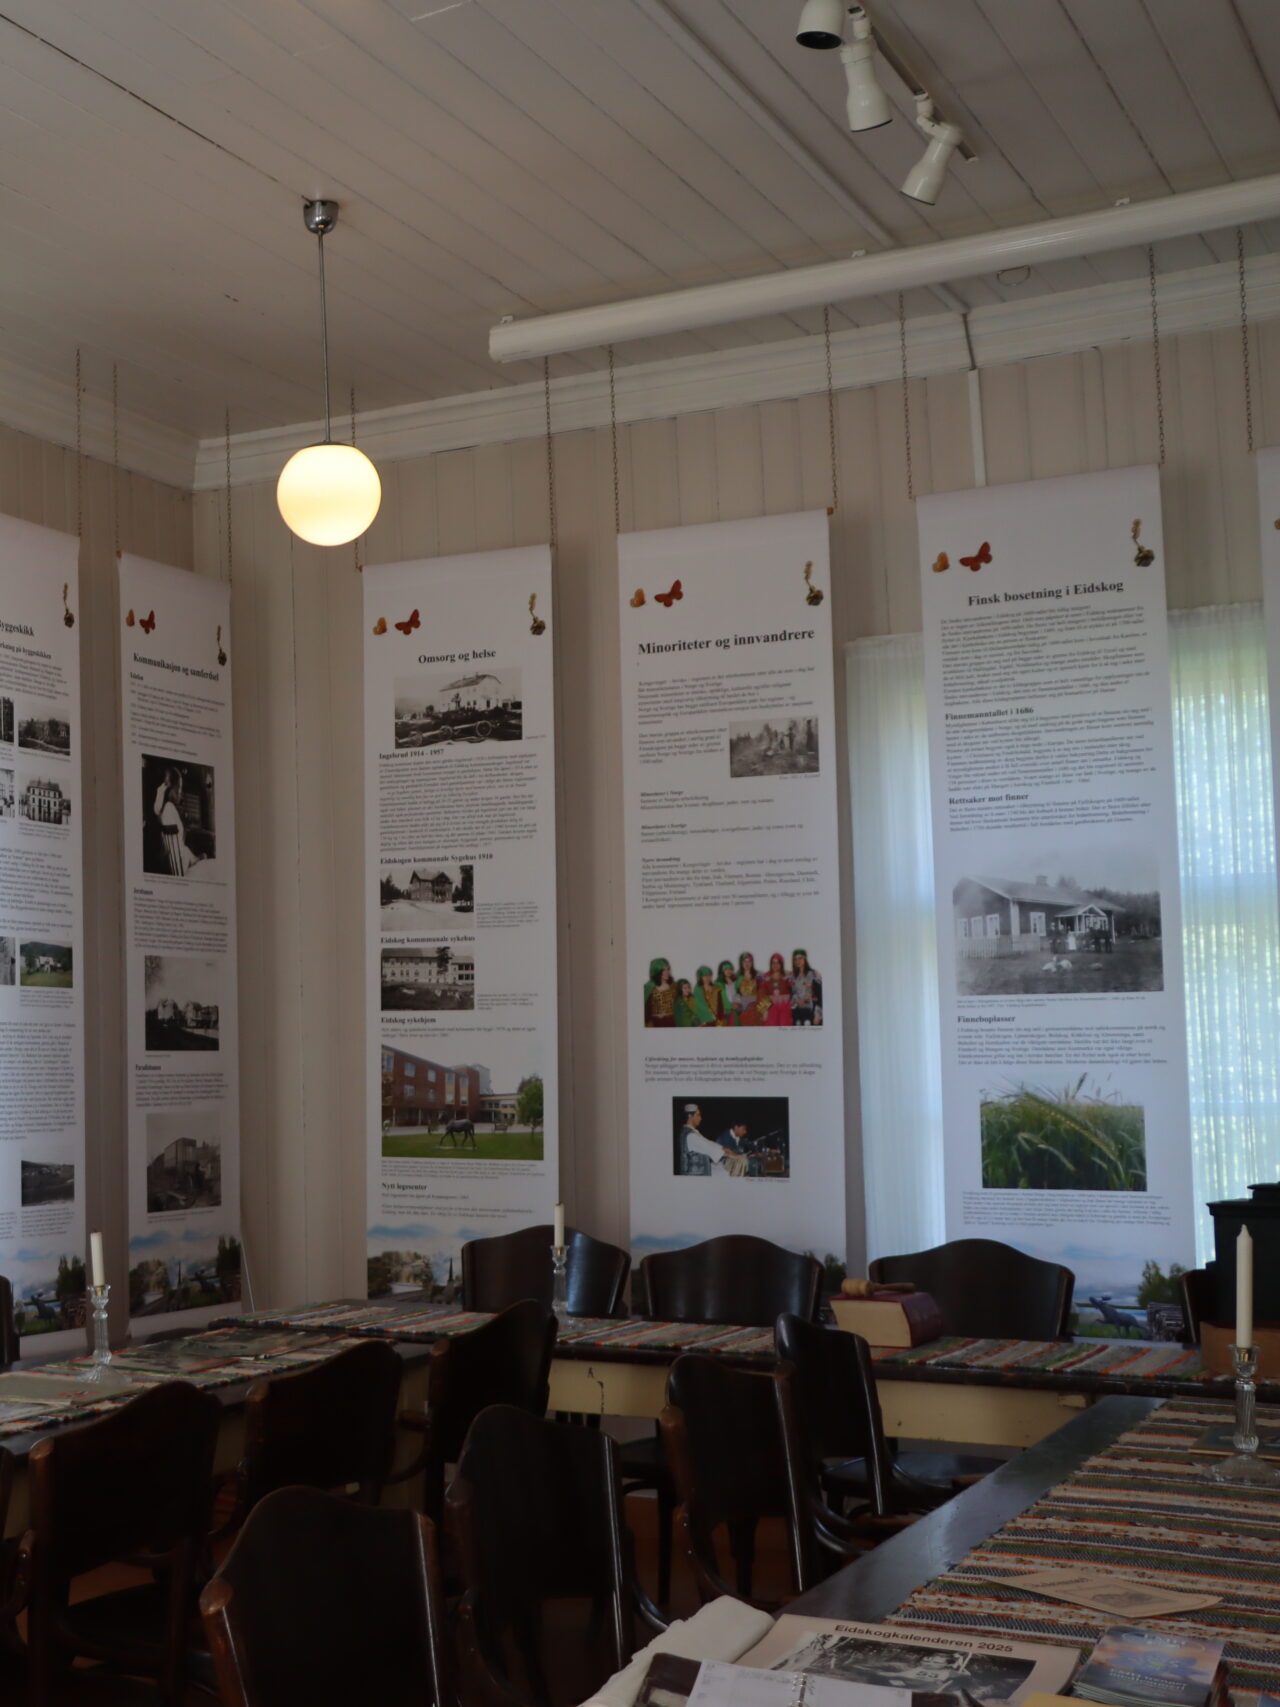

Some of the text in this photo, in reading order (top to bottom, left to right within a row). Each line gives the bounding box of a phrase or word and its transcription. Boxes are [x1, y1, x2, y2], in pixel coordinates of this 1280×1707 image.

[968, 582, 1124, 607] Finsk bosetning i Eidskog
[639, 630, 815, 655] Minoriteter og innvandrere
[418, 649, 496, 664] Omsorg og helse
[835, 1624, 1013, 1652] Eidskogkalenderen 2025
